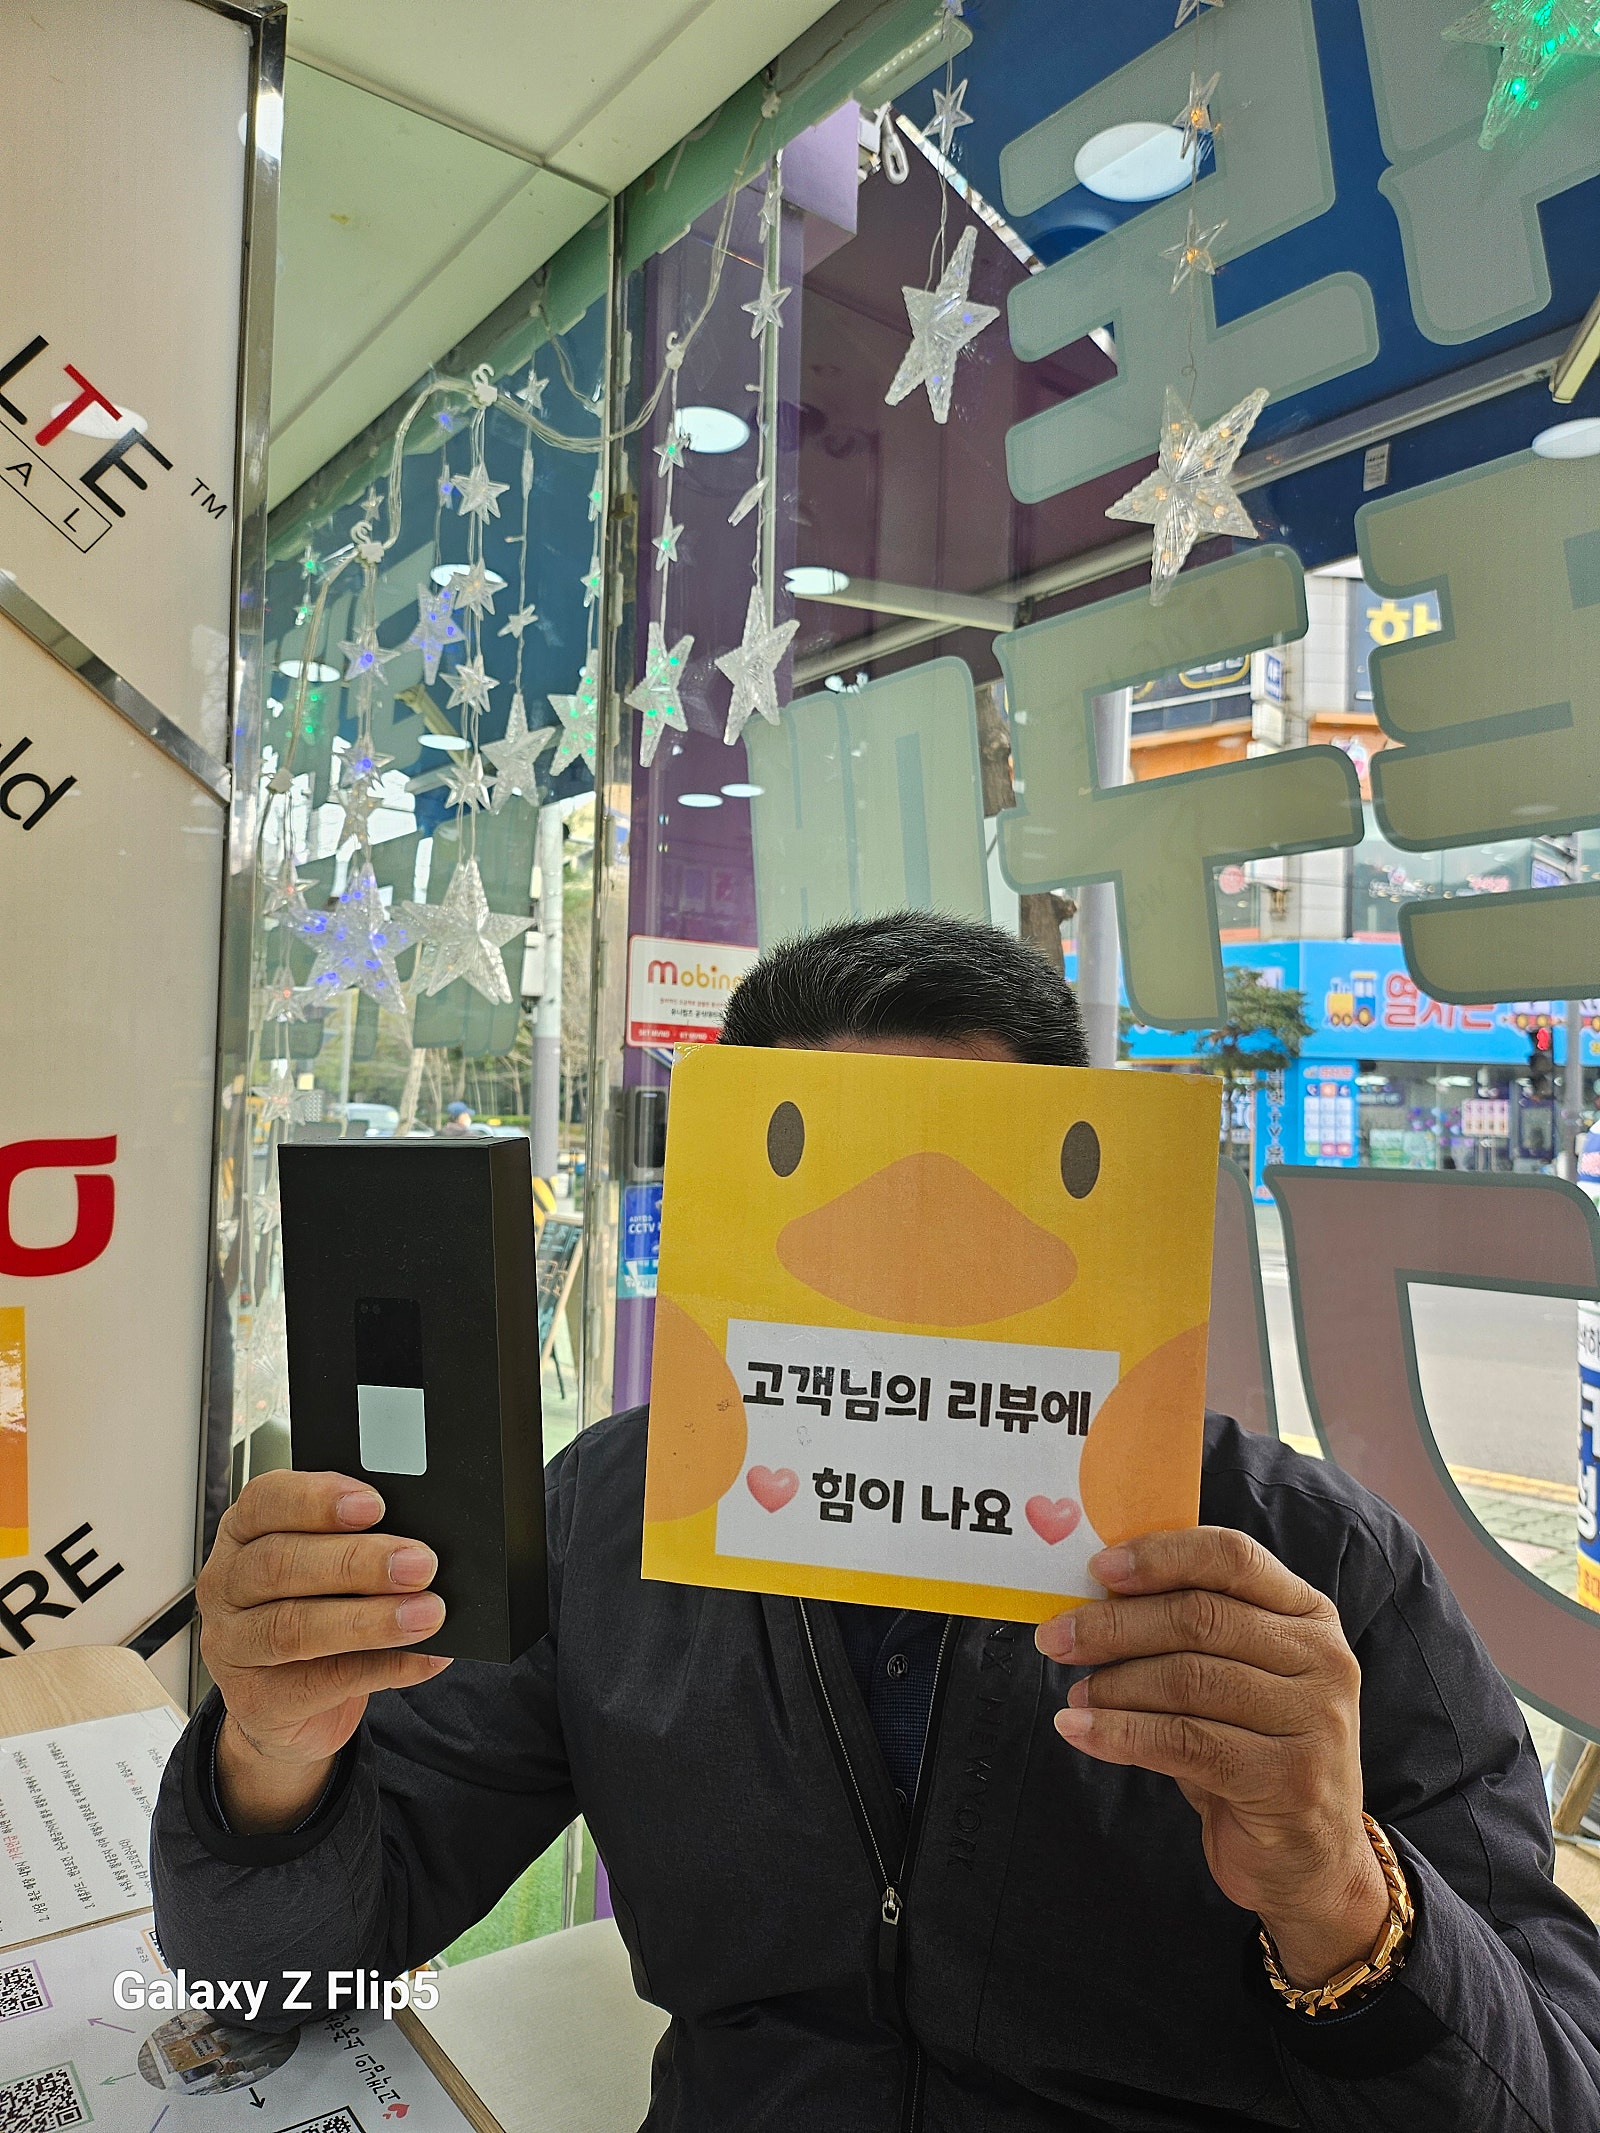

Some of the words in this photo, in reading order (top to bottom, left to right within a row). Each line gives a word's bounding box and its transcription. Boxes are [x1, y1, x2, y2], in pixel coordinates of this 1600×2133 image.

[628, 1221, 656, 1235] CCTV
[742, 1361, 932, 1422] 고객님의
[947, 1379, 1092, 1436] 리뷰에
[812, 1466, 904, 1524] 힘이
[921, 1485, 1013, 1536] 나요
[324, 2014, 365, 2050] 소중한
[355, 2053, 401, 2104] 고객님의
